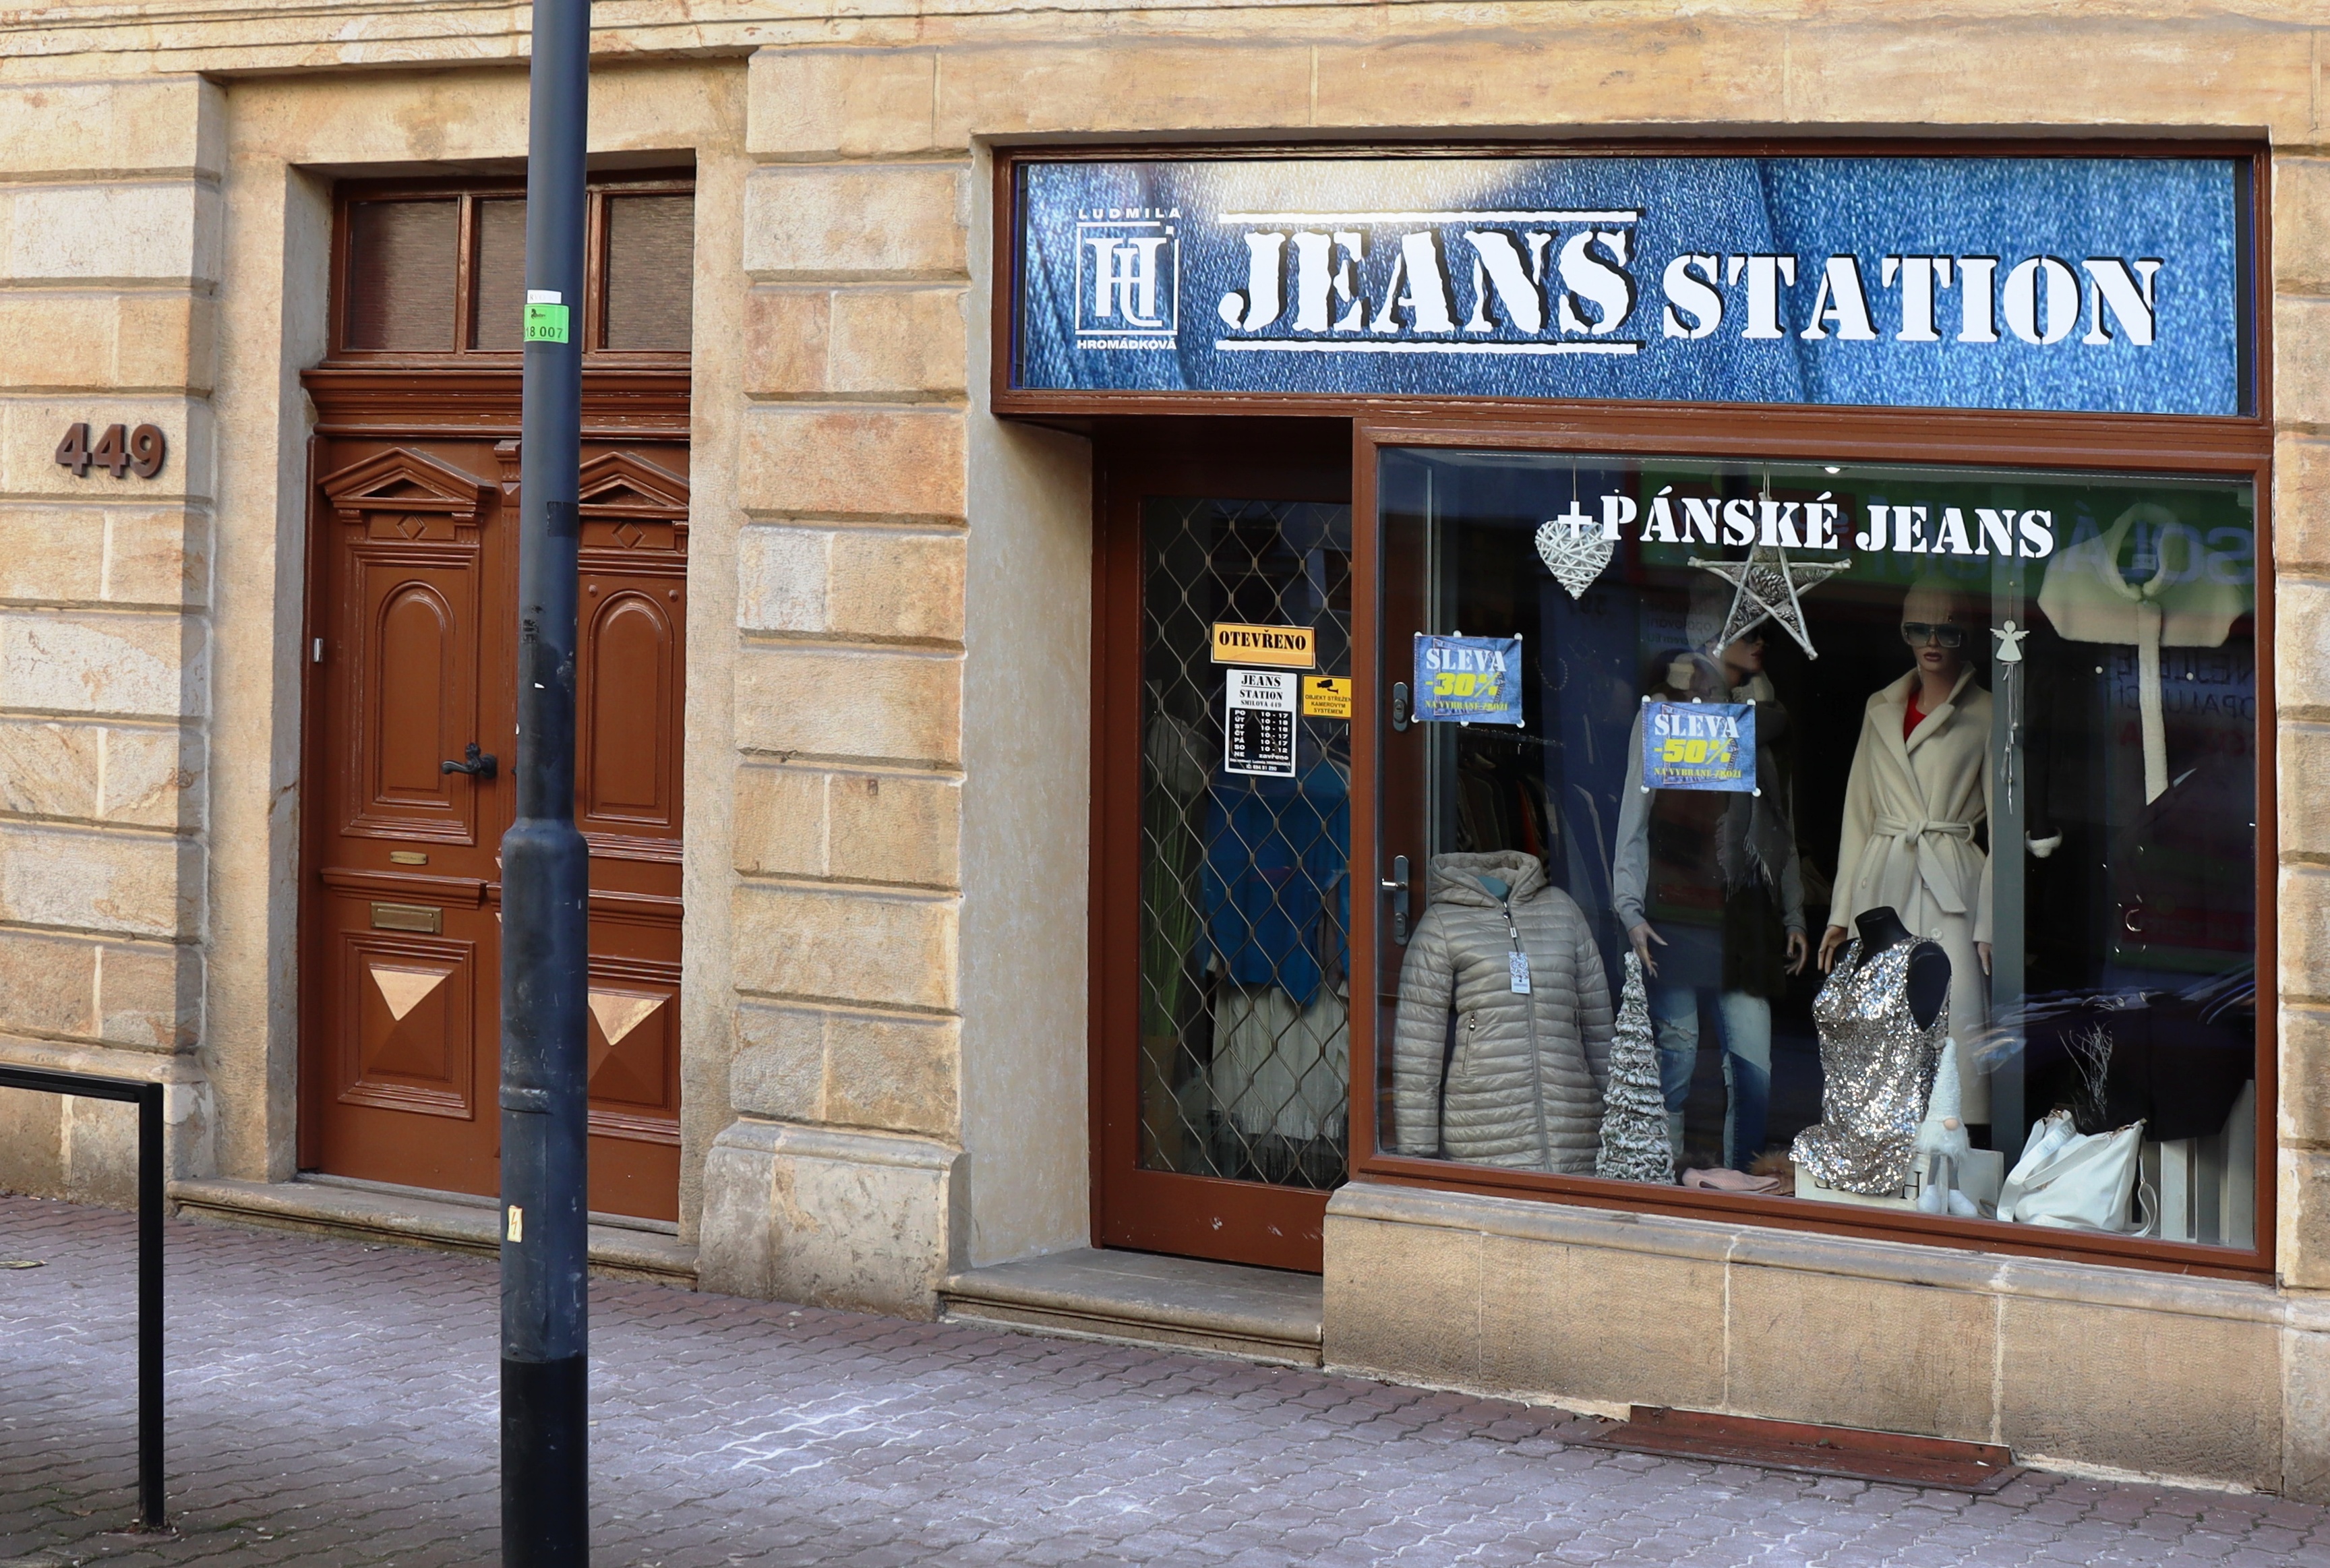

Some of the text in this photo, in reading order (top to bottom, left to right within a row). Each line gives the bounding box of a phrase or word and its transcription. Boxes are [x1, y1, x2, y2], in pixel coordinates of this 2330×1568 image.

[1079, 208, 1181, 219] LUDMILA
[1217, 228, 2163, 346] JEANS STATION
[539, 326, 564, 338] 007
[1077, 338, 1177, 350] HROMÁDKOVÁ
[55, 423, 166, 479] 449
[1855, 504, 2054, 559] JEANS
[1219, 629, 1307, 651] OTEVŘENO
[1426, 648, 1507, 672] SLEVA
[1241, 675, 1282, 687] JEANS
[1425, 672, 1499, 698] -30%
[1239, 689, 1283, 700] STATION
[1425, 700, 1438, 708] NA
[1654, 714, 1740, 738] SLEVA
[1653, 738, 1733, 765] -50%
[1654, 767, 1667, 776] NA
